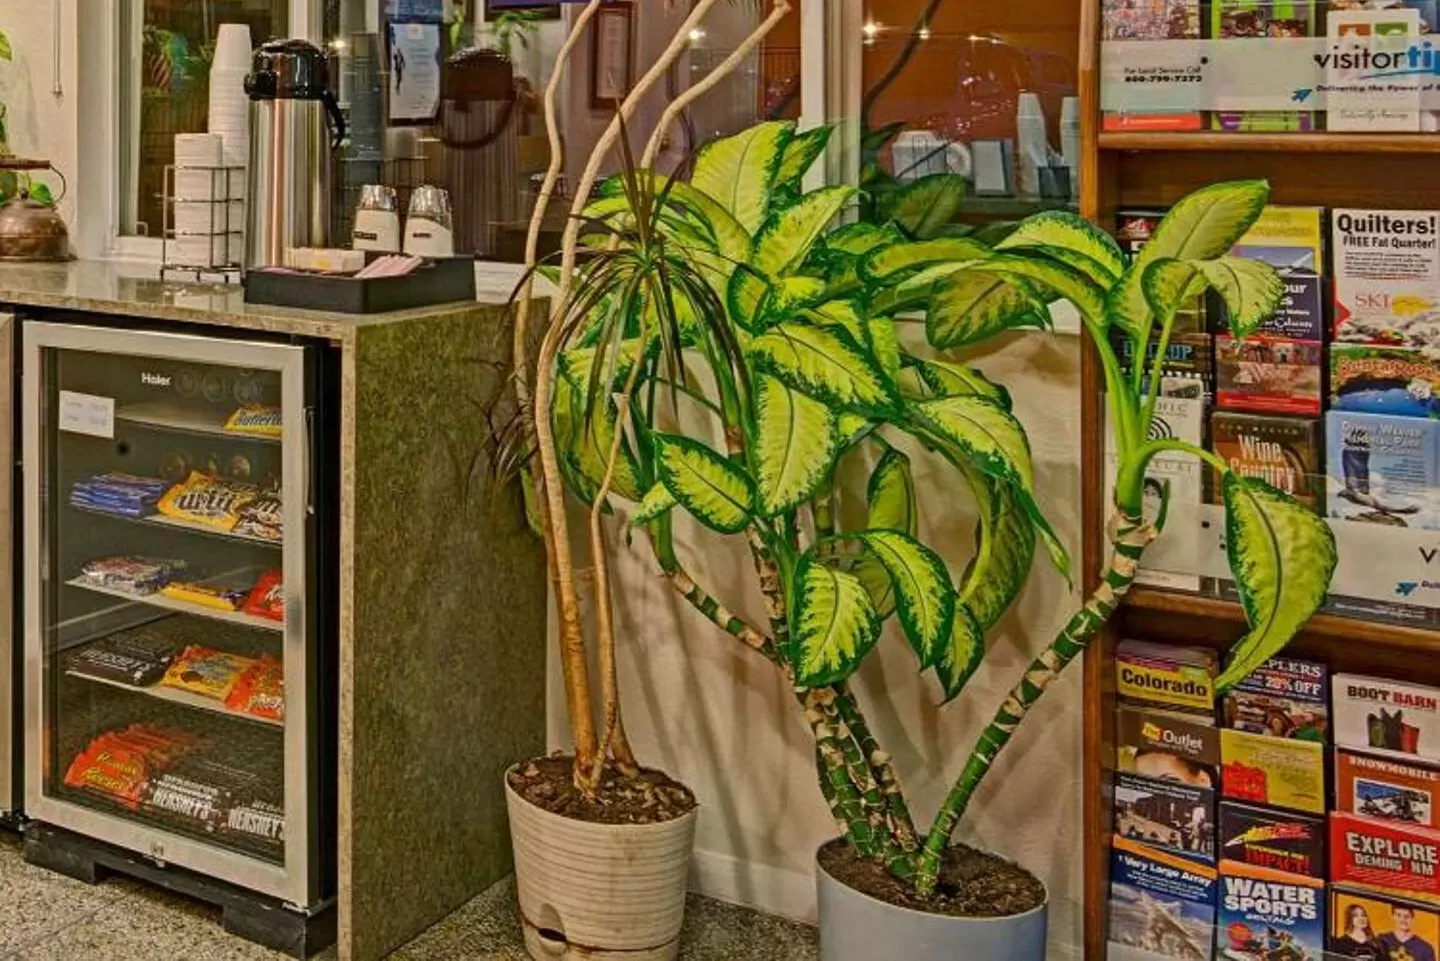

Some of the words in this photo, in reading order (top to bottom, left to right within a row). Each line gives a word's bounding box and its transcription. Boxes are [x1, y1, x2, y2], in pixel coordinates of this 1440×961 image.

[1337, 214, 1436, 236] Quilters!
[1343, 235, 1370, 248] FREE
[1391, 237, 1436, 250] Quarter!
[140, 372, 172, 386] Haier
[1238, 434, 1282, 462] Wine
[1122, 668, 1207, 696] Colorado
[1295, 680, 1322, 695] OFF
[1347, 685, 1390, 701] BOOT
[1393, 691, 1437, 709] BARN
[1163, 730, 1203, 750] Outlet
[1346, 831, 1439, 865] EXPLORE
[1125, 856, 1149, 872] Very
[1150, 863, 1180, 878] Large
[1181, 871, 1213, 888] Array
[1355, 853, 1403, 872] DEMING
[1410, 861, 1434, 877] NM
[1224, 878, 1317, 905] WATER
[1224, 894, 1318, 921] SPORTS
